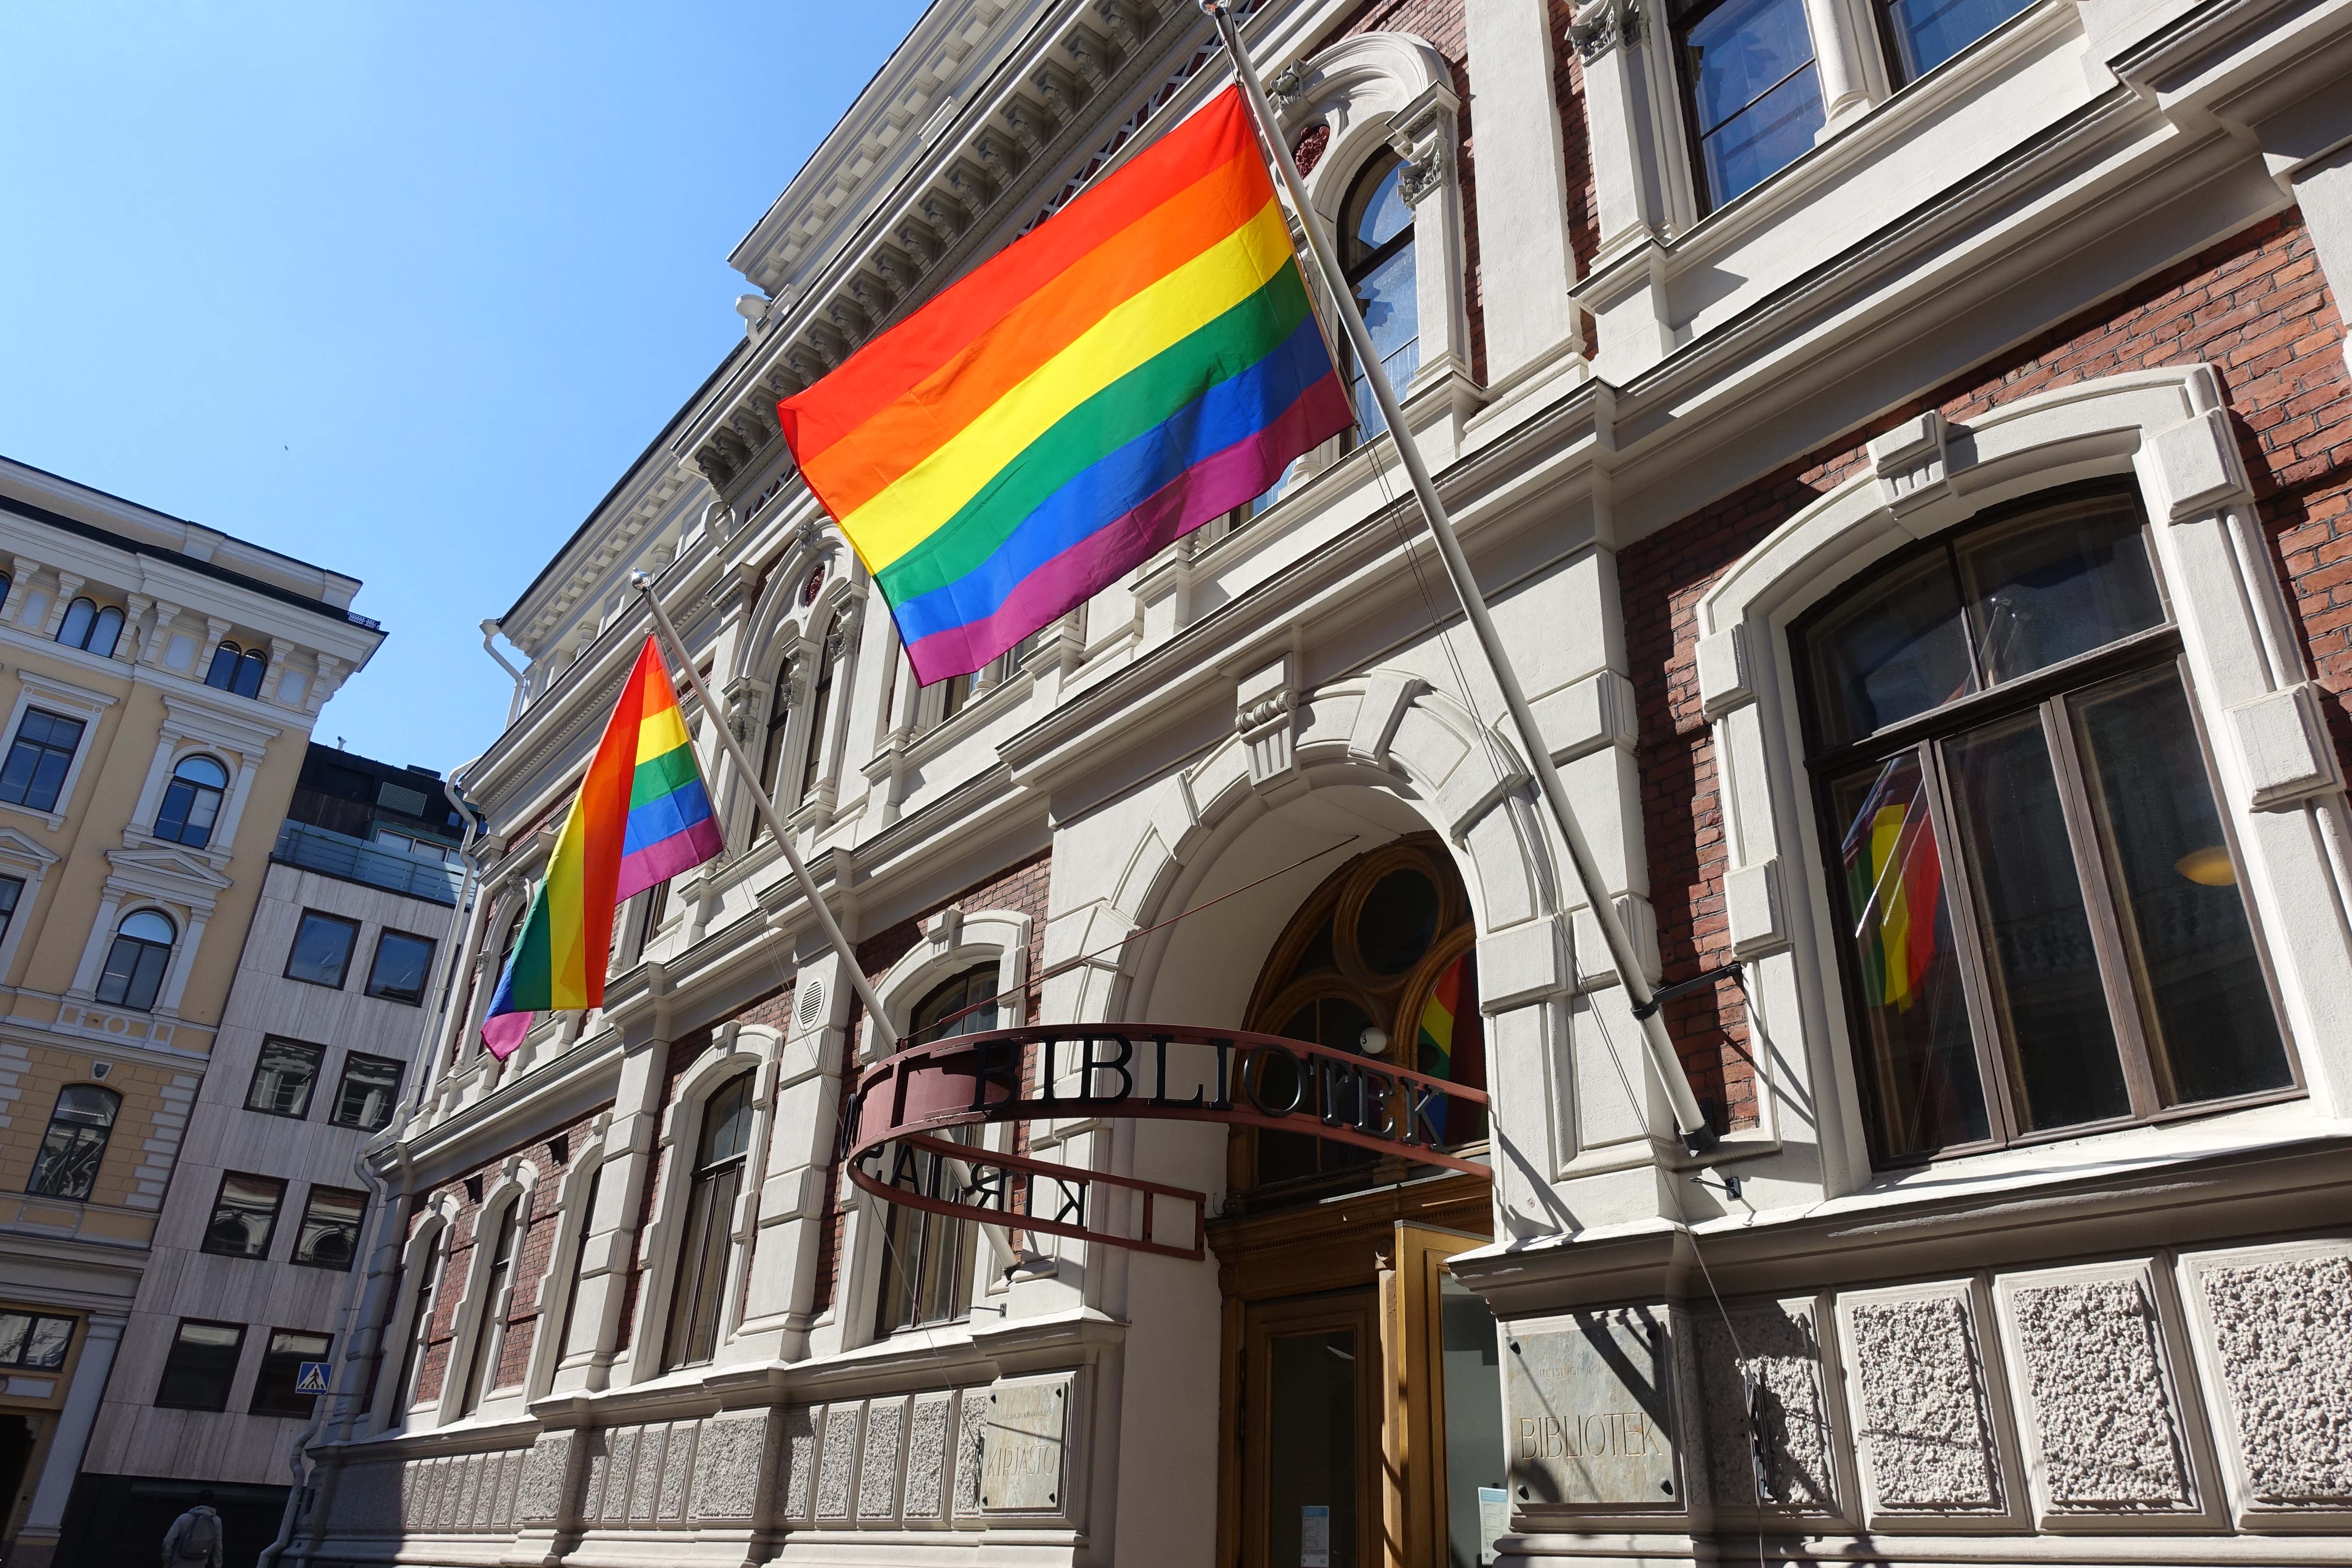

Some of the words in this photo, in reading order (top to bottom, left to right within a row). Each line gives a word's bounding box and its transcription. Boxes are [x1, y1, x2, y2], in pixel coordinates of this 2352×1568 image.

[1361, 1035, 1367, 1044] 3
[969, 1033, 1449, 1154] BIBLIOTEK
[1520, 1412, 1664, 1460] BIBLIOTEK
[988, 1445, 1056, 1477] KIRJASTO
